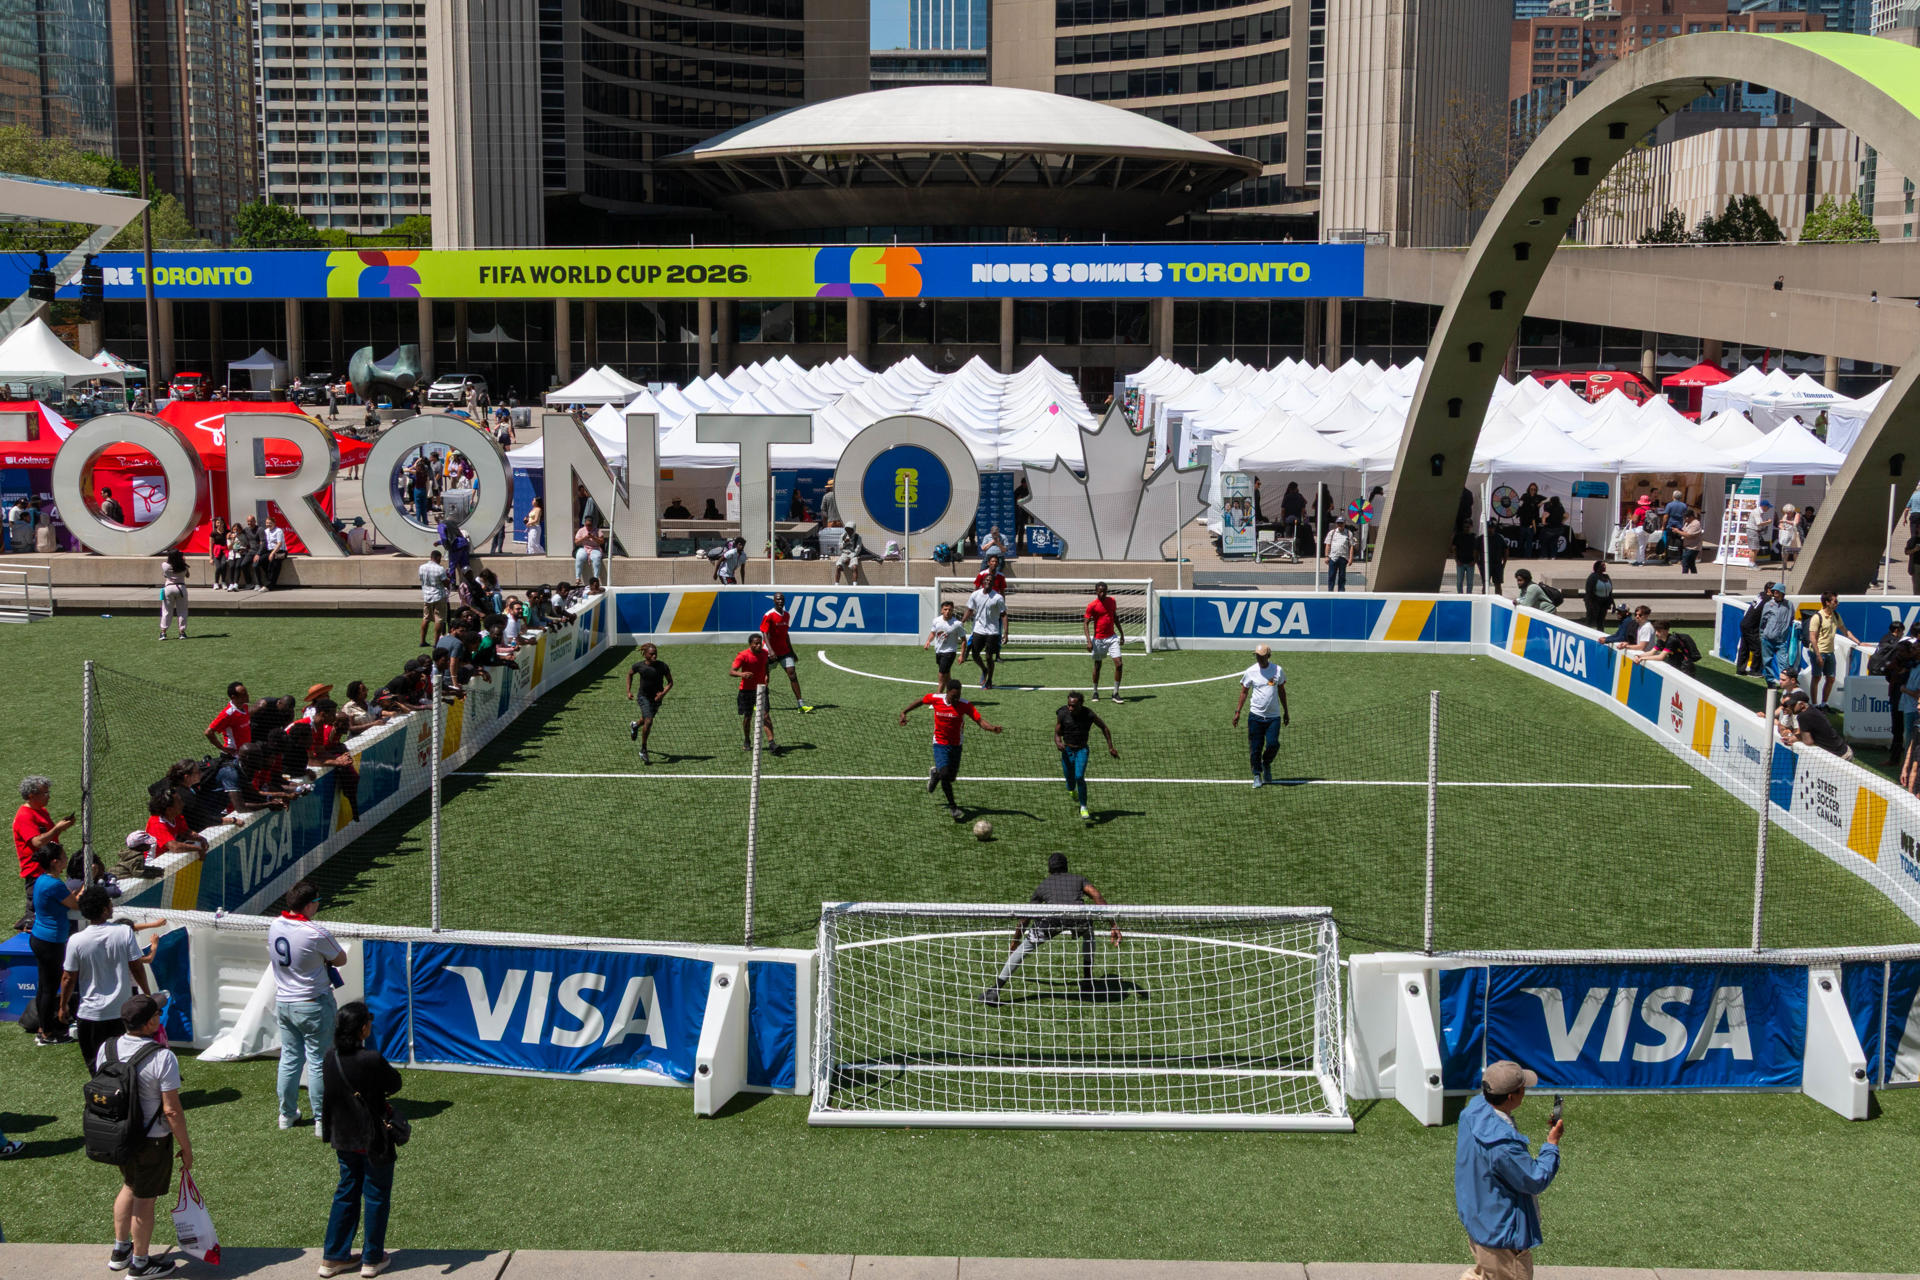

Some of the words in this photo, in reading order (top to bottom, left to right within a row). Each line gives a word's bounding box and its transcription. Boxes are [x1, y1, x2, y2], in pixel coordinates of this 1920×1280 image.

[137, 267, 252, 285] TORONTO
[479, 266, 526, 284] FIFA
[530, 265, 612, 284] WORLD
[616, 265, 661, 284] CUP
[666, 264, 748, 284] 2026
[972, 264, 1047, 282] NOUS
[1053, 263, 1163, 282] SOMMES
[1168, 262, 1311, 282] TORONTO
[13, 456, 50, 464] Loblaws
[0, 411, 980, 559] ORONTO
[1208, 601, 1310, 635] VISA
[1546, 626, 1587, 679] VISA
[1817, 778, 1838, 798] STREET
[1817, 791, 1840, 814] SOCCER
[1817, 806, 1842, 830] CANADA
[232, 809, 293, 895] VISA
[275, 937, 292, 967] 9
[442, 966, 668, 1050] VISA
[1520, 986, 1754, 1063] VISA
